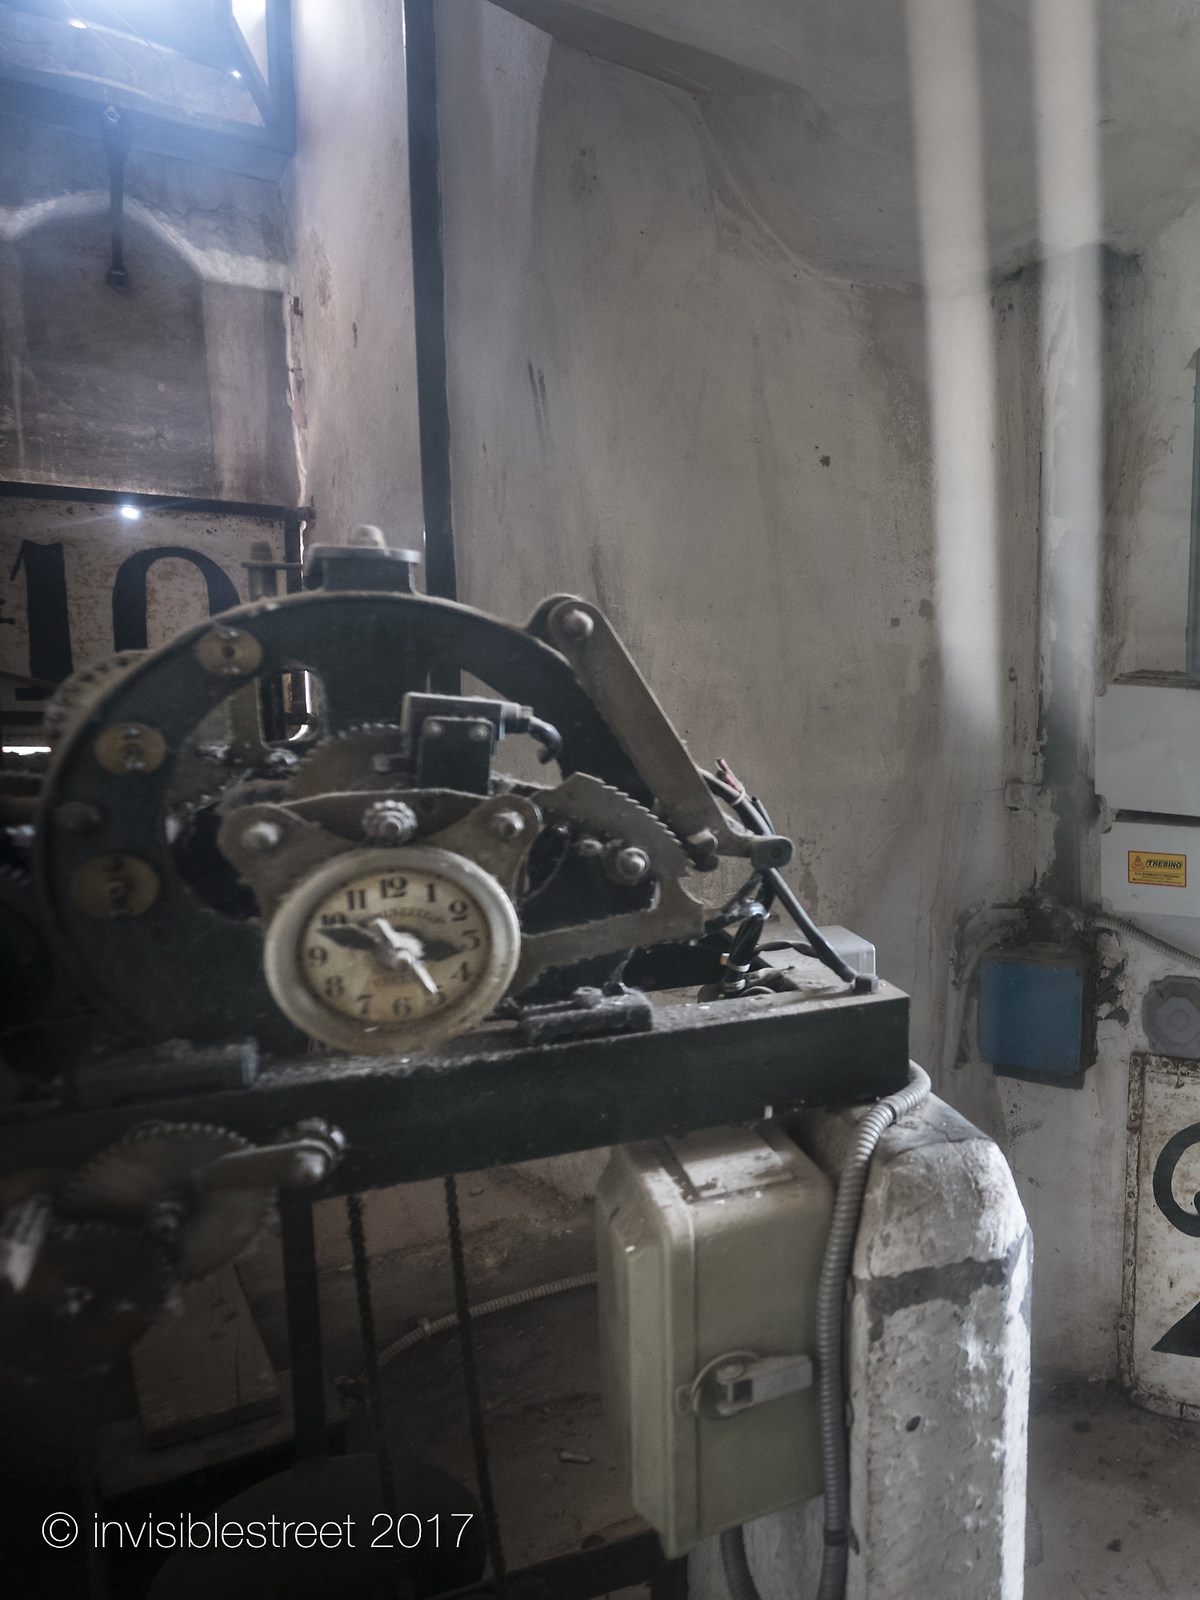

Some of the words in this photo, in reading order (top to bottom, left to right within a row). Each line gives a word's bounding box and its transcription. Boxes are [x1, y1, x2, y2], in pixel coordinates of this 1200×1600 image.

[1147, 859, 1182, 869] TREBINO
[380, 876, 407, 898] 12
[427, 883, 436, 902] 1
[347, 889, 366, 910] 11
[449, 901, 467, 921] 2
[307, 946, 328, 968] 9
[450, 961, 473, 982] 4
[325, 975, 344, 998] 8
[356, 993, 373, 1015] 7
[392, 996, 412, 1017] 6
